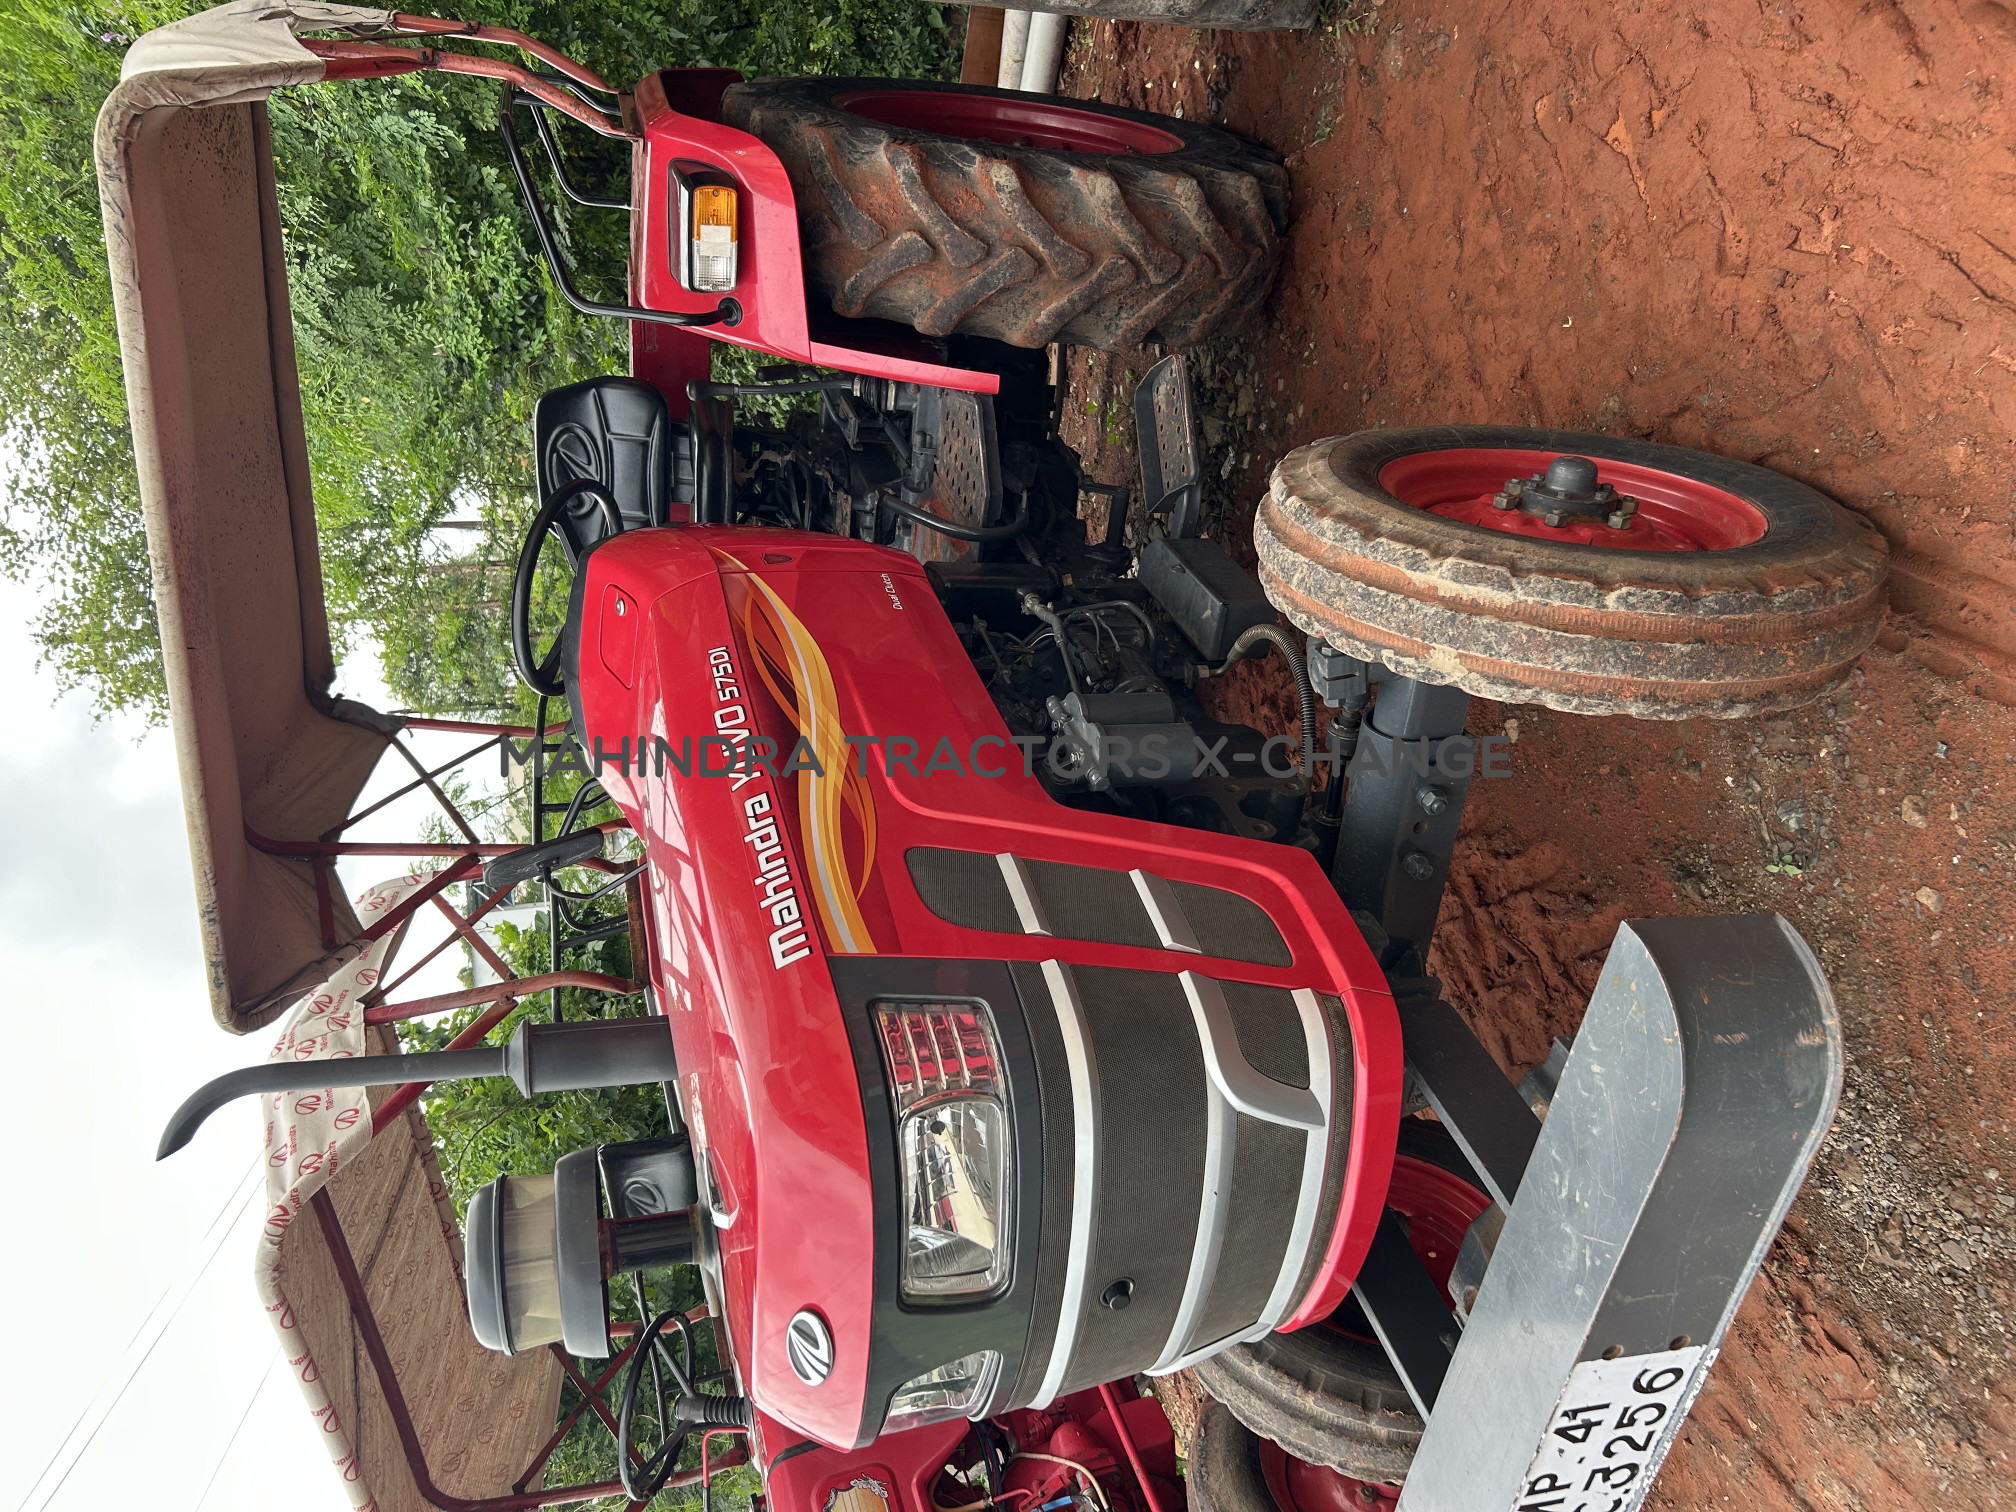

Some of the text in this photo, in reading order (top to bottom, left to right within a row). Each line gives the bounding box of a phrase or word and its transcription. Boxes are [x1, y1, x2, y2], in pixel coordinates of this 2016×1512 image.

[881, 573, 903, 608] Dual Clutch
[707, 646, 813, 971] Mahindra YUVO 575DI
